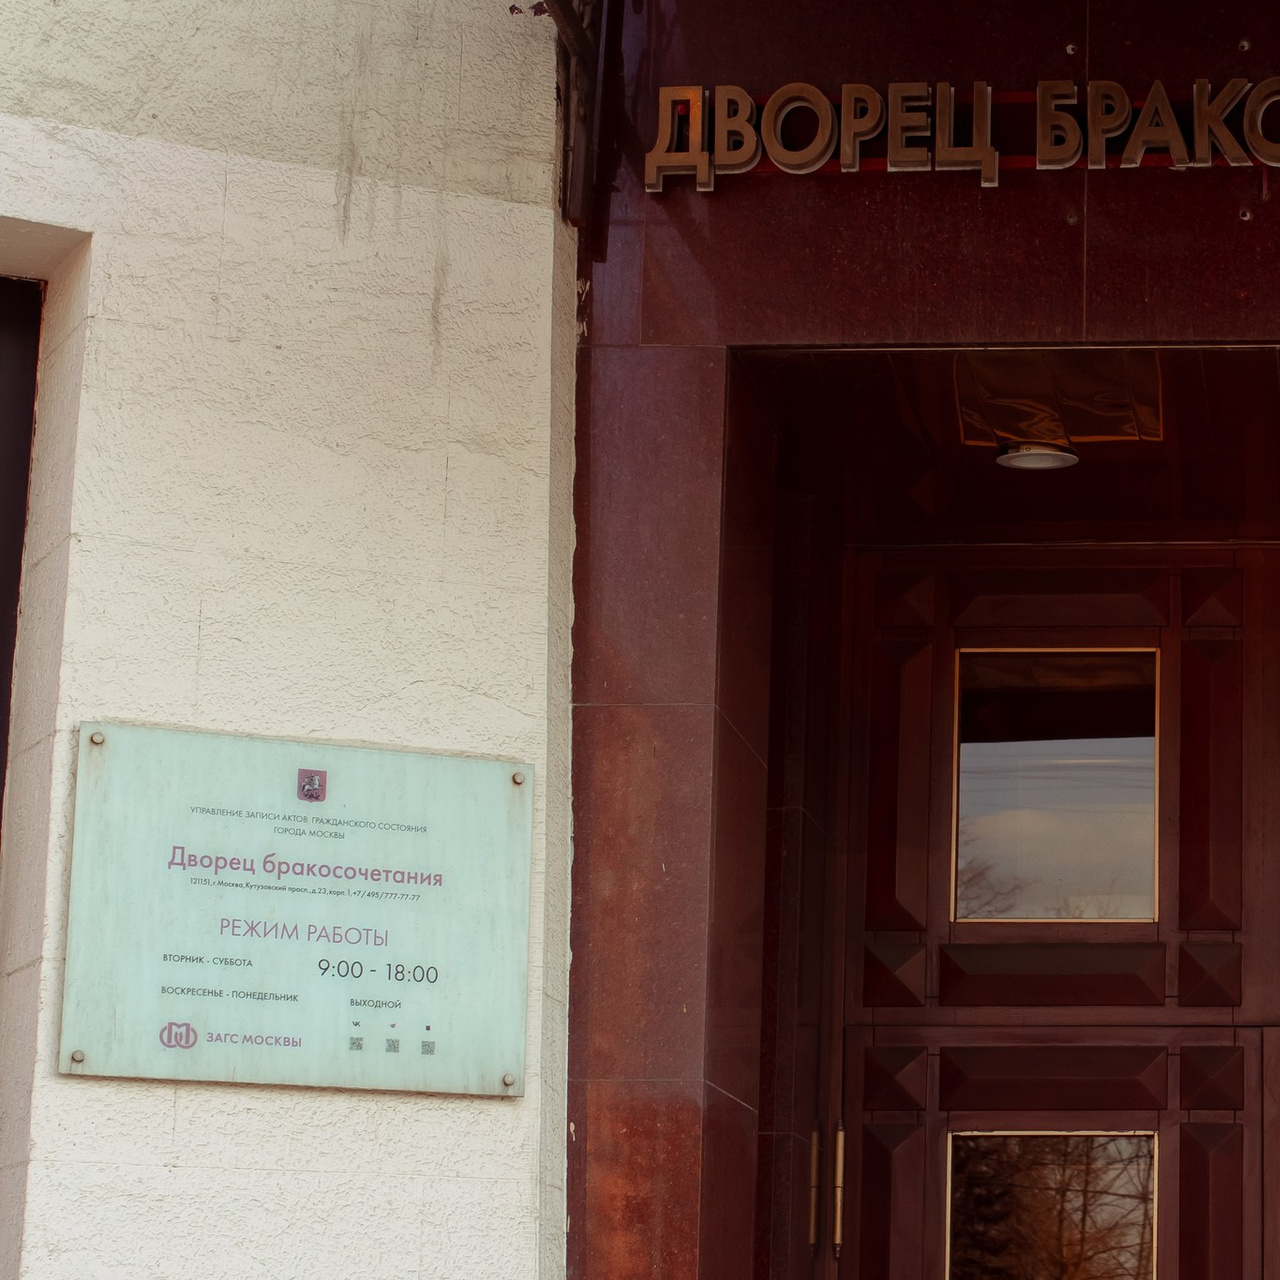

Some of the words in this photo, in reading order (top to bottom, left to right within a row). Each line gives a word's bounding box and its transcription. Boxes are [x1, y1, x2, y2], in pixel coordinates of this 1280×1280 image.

[644, 80, 1001, 192] ДВОРЕЦ
[190, 806, 243, 818] УПРАВЛЕНИЕ
[245, 810, 280, 821] ЗАПИСИ
[282, 813, 308, 823] АКТОВ
[311, 816, 376, 829] ГРАЖДАНСКОГО
[377, 822, 428, 834] СОСТОЯНИЯ
[273, 826, 307, 837] ГОРОДА
[308, 829, 345, 840] МОСКВЫ
[168, 845, 255, 876] Дворец
[262, 852, 443, 887] бракосочетания
[219, 918, 299, 941] РЕЖИМ
[306, 924, 389, 947] РАБОТЫ
[163, 954, 205, 965] ВТОРНИК
[212, 957, 253, 968] СУББОТА
[318, 959, 364, 980] 9:00
[385, 963, 439, 984] 18:00
[161, 986, 224, 998] ВОСКРЕСЕНЬЕ
[231, 990, 299, 1002] ПОНЕДЕЛЬНИК
[350, 998, 402, 1009] ВЫХОДНОЙ
[206, 1032, 239, 1044] ЗАГС
[242, 1034, 302, 1047] МОСКВЫ
